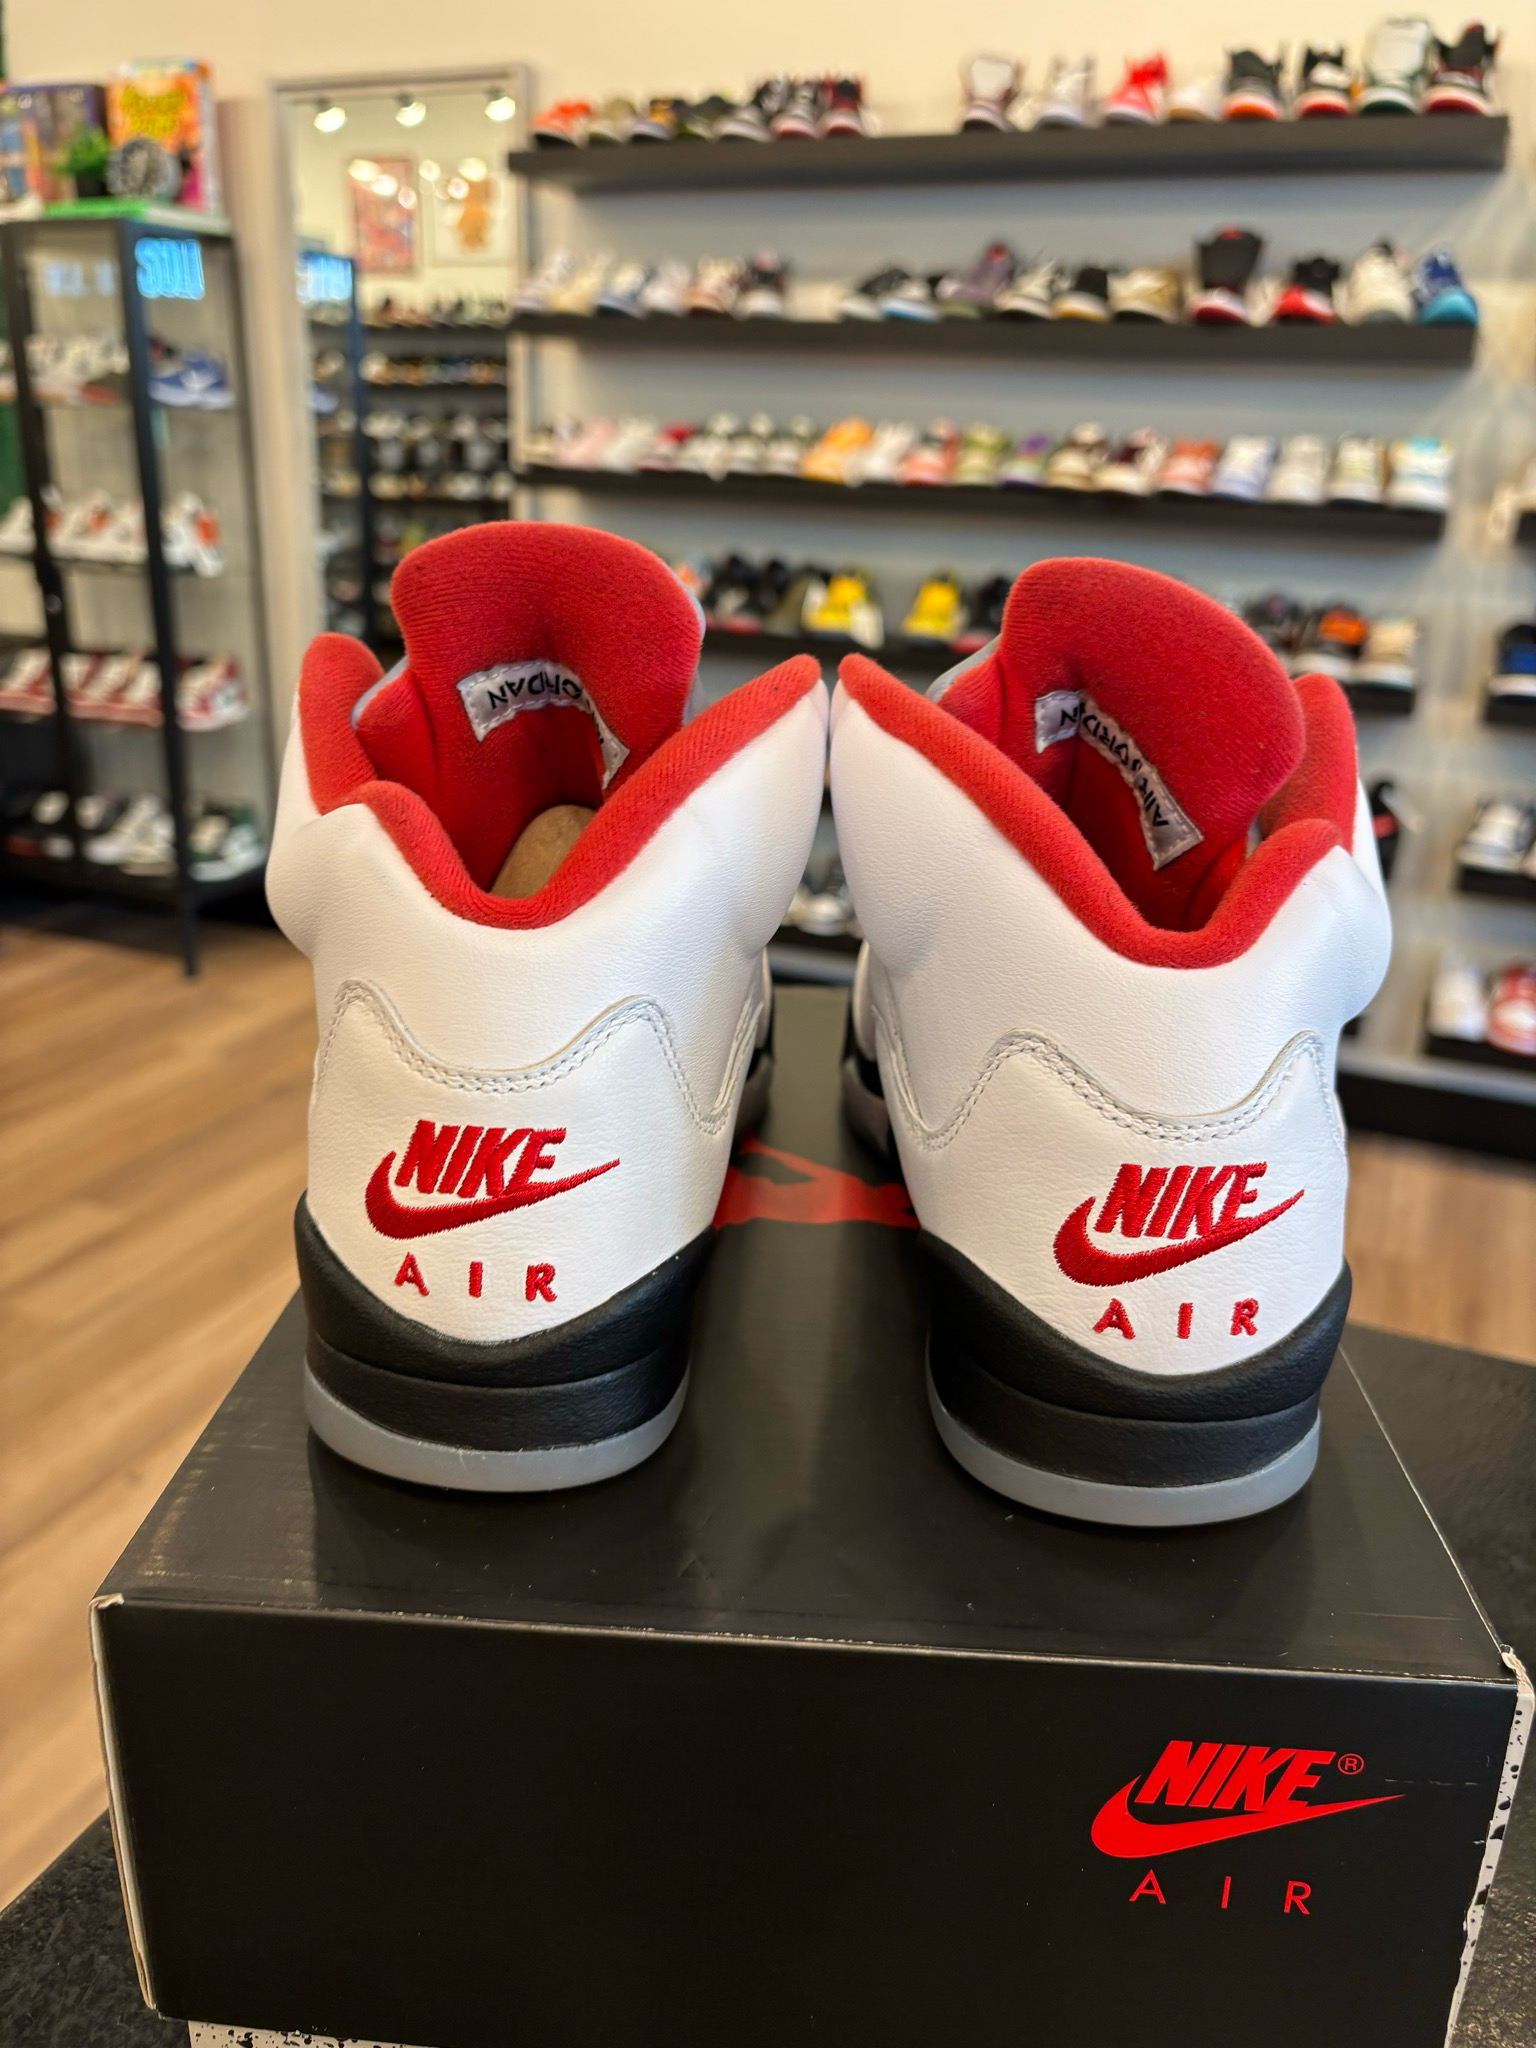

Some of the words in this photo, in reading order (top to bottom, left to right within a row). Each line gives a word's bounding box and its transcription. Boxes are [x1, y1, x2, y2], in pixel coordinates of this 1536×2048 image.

[486, 671, 585, 710] ORDAN
[1138, 777, 1169, 827] AIR
[394, 1119, 567, 1198] NIKE
[1094, 1161, 1268, 1239] NIKE
[394, 1251, 558, 1302] AIR
[1092, 1297, 1259, 1340] AIR
[1129, 1869, 1312, 1915] AIR
